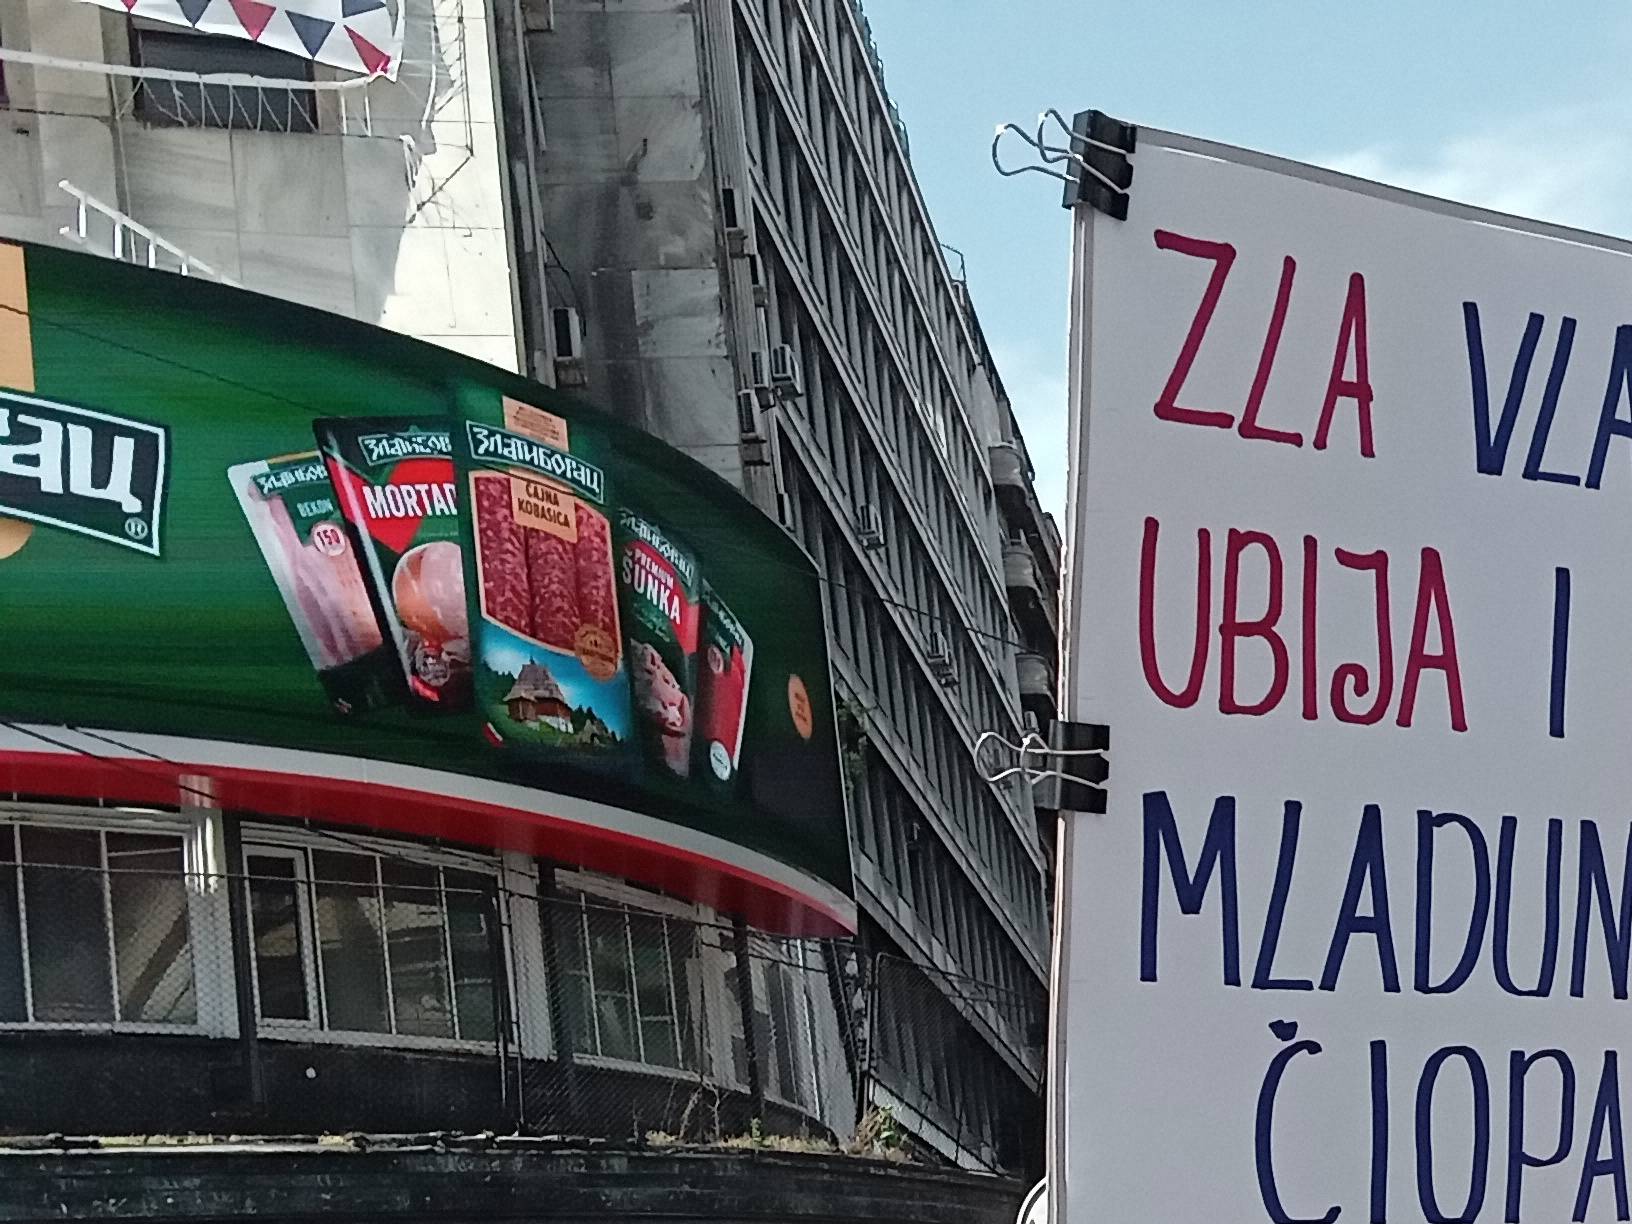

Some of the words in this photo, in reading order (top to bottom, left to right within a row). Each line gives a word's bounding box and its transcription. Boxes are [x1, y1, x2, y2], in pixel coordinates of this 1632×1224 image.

[1154, 230, 1375, 458] ZLA
[0, 408, 143, 513] ац
[517, 498, 571, 529] KOBASICA
[622, 546, 681, 625] ŠUNKA
[1138, 516, 1468, 733] UBIJA
[1549, 567, 1570, 738] I
